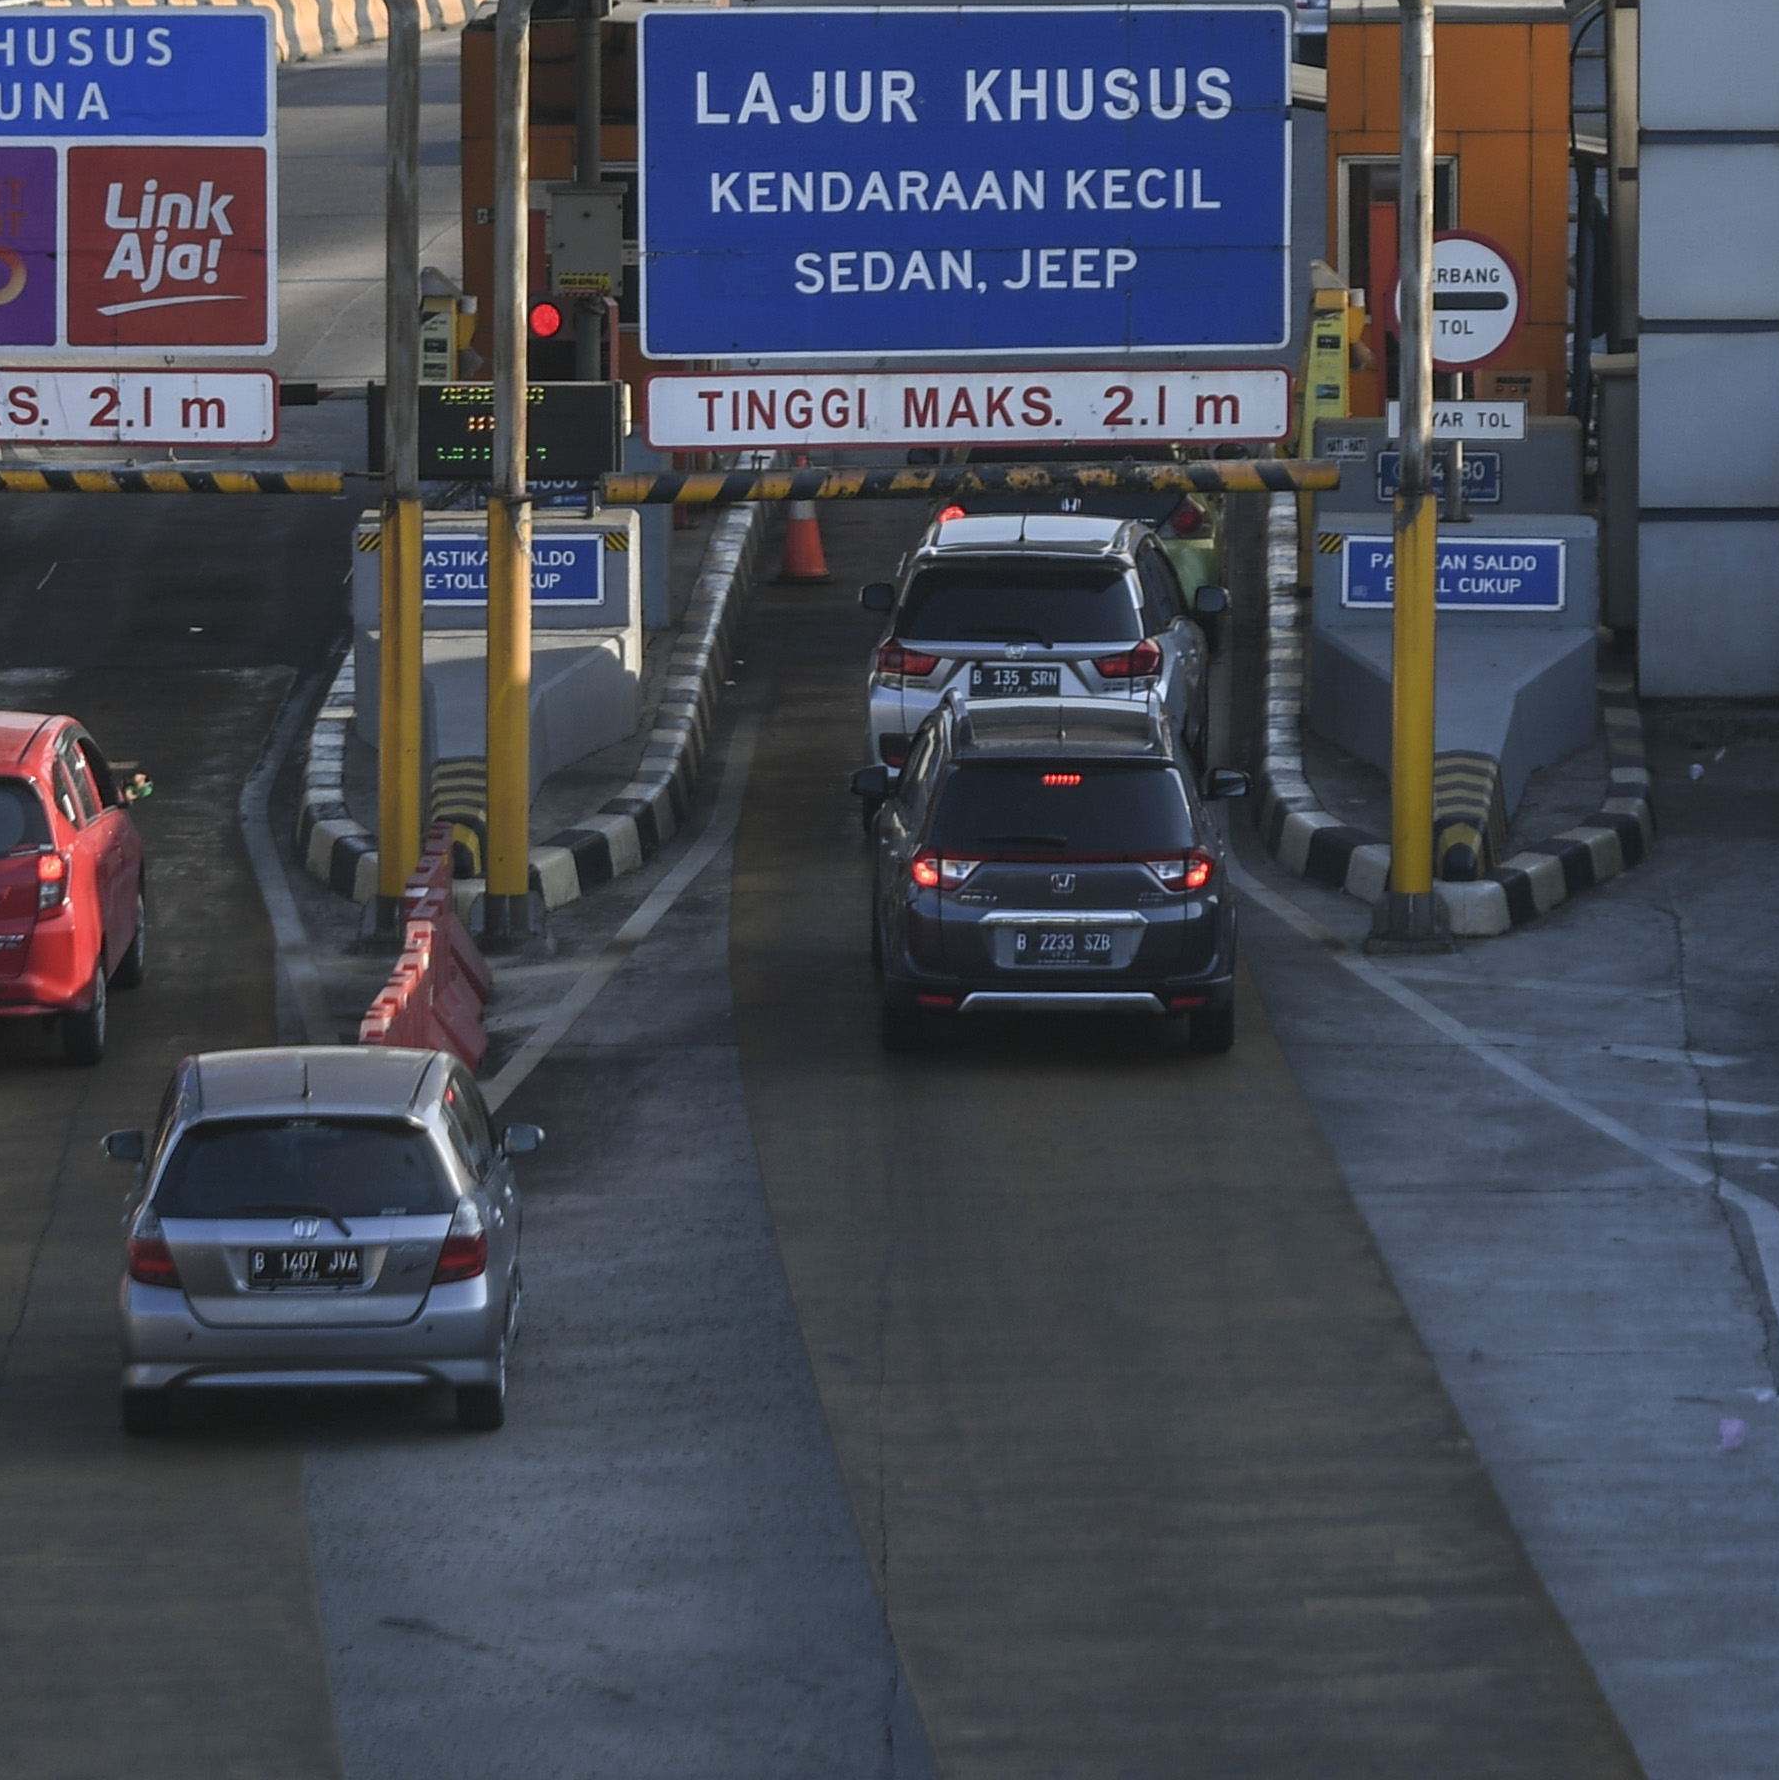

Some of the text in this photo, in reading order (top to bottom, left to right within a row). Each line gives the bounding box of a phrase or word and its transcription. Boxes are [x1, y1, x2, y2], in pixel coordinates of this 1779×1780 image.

[695, 67, 1233, 124] LAJUR KHUSUS
[711, 168, 1221, 213] KENDARAAN KECIL
[105, 178, 234, 236] Link
[104, 227, 223, 293] Aja!
[794, 248, 1137, 294] SEDAN, JEEP
[1439, 320, 1474, 334] TOL
[181, 397, 226, 428] m
[697, 388, 867, 432] TINGGI
[903, 386, 1063, 428] MAKS.
[1195, 394, 1241, 425] m
[1478, 412, 1511, 427] TOL
[1473, 555, 1537, 571] SALDO
[425, 574, 488, 589] E-TOLL
[1459, 577, 1522, 593] CUKUP
[973, 669, 1057, 686] B 135 SRN
[1017, 933, 1111, 951] B 2233 SZB
[254, 1251, 359, 1271] B 1407 JVA
